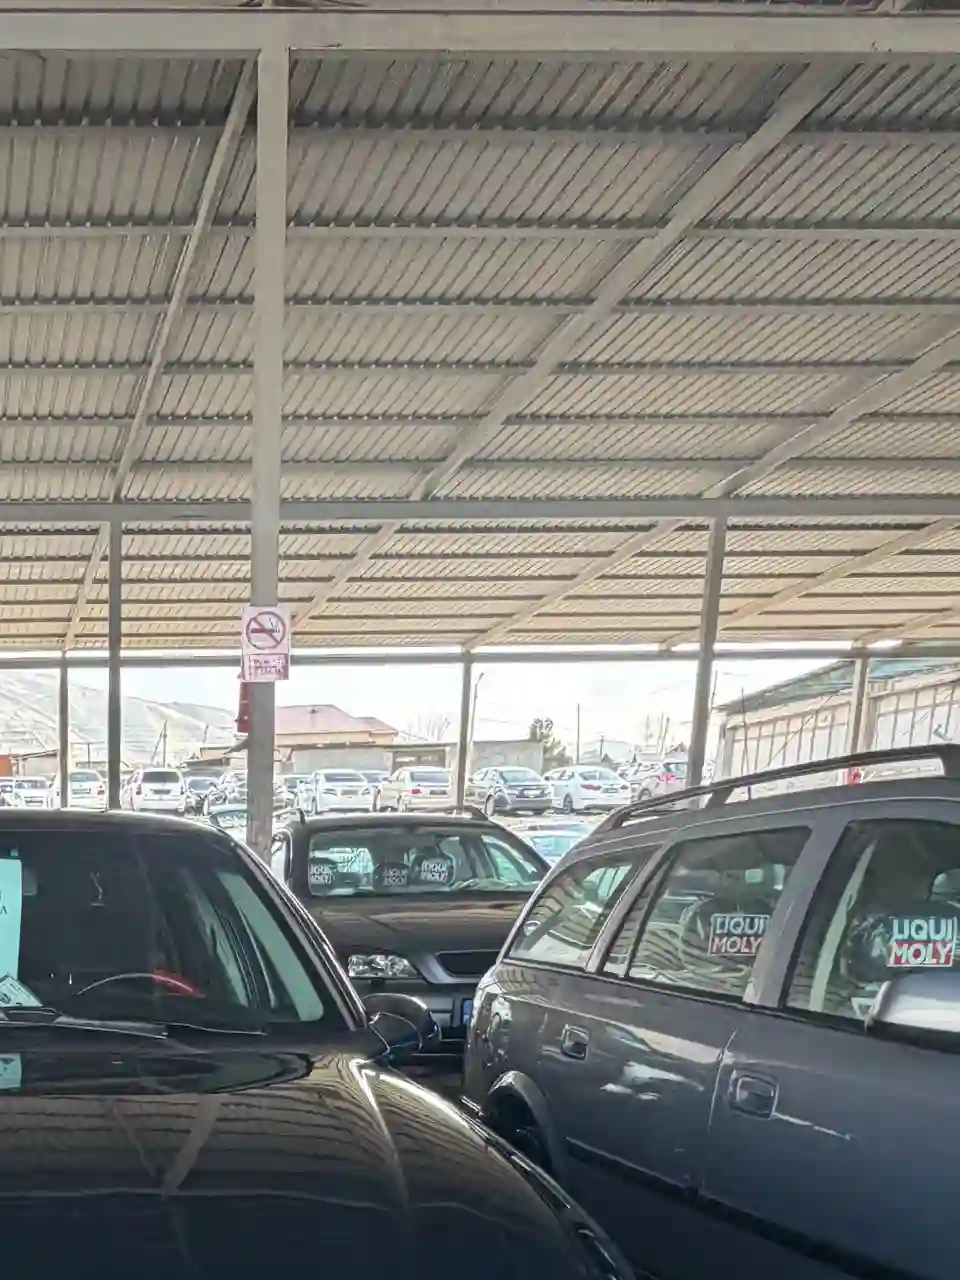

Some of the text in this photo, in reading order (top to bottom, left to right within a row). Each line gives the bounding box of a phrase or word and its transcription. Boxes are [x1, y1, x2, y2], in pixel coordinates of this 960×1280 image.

[715, 916, 765, 935] LIQUI
[891, 917, 953, 941] LIQUI
[712, 936, 763, 954] MOLY
[889, 941, 952, 965] MOLY
